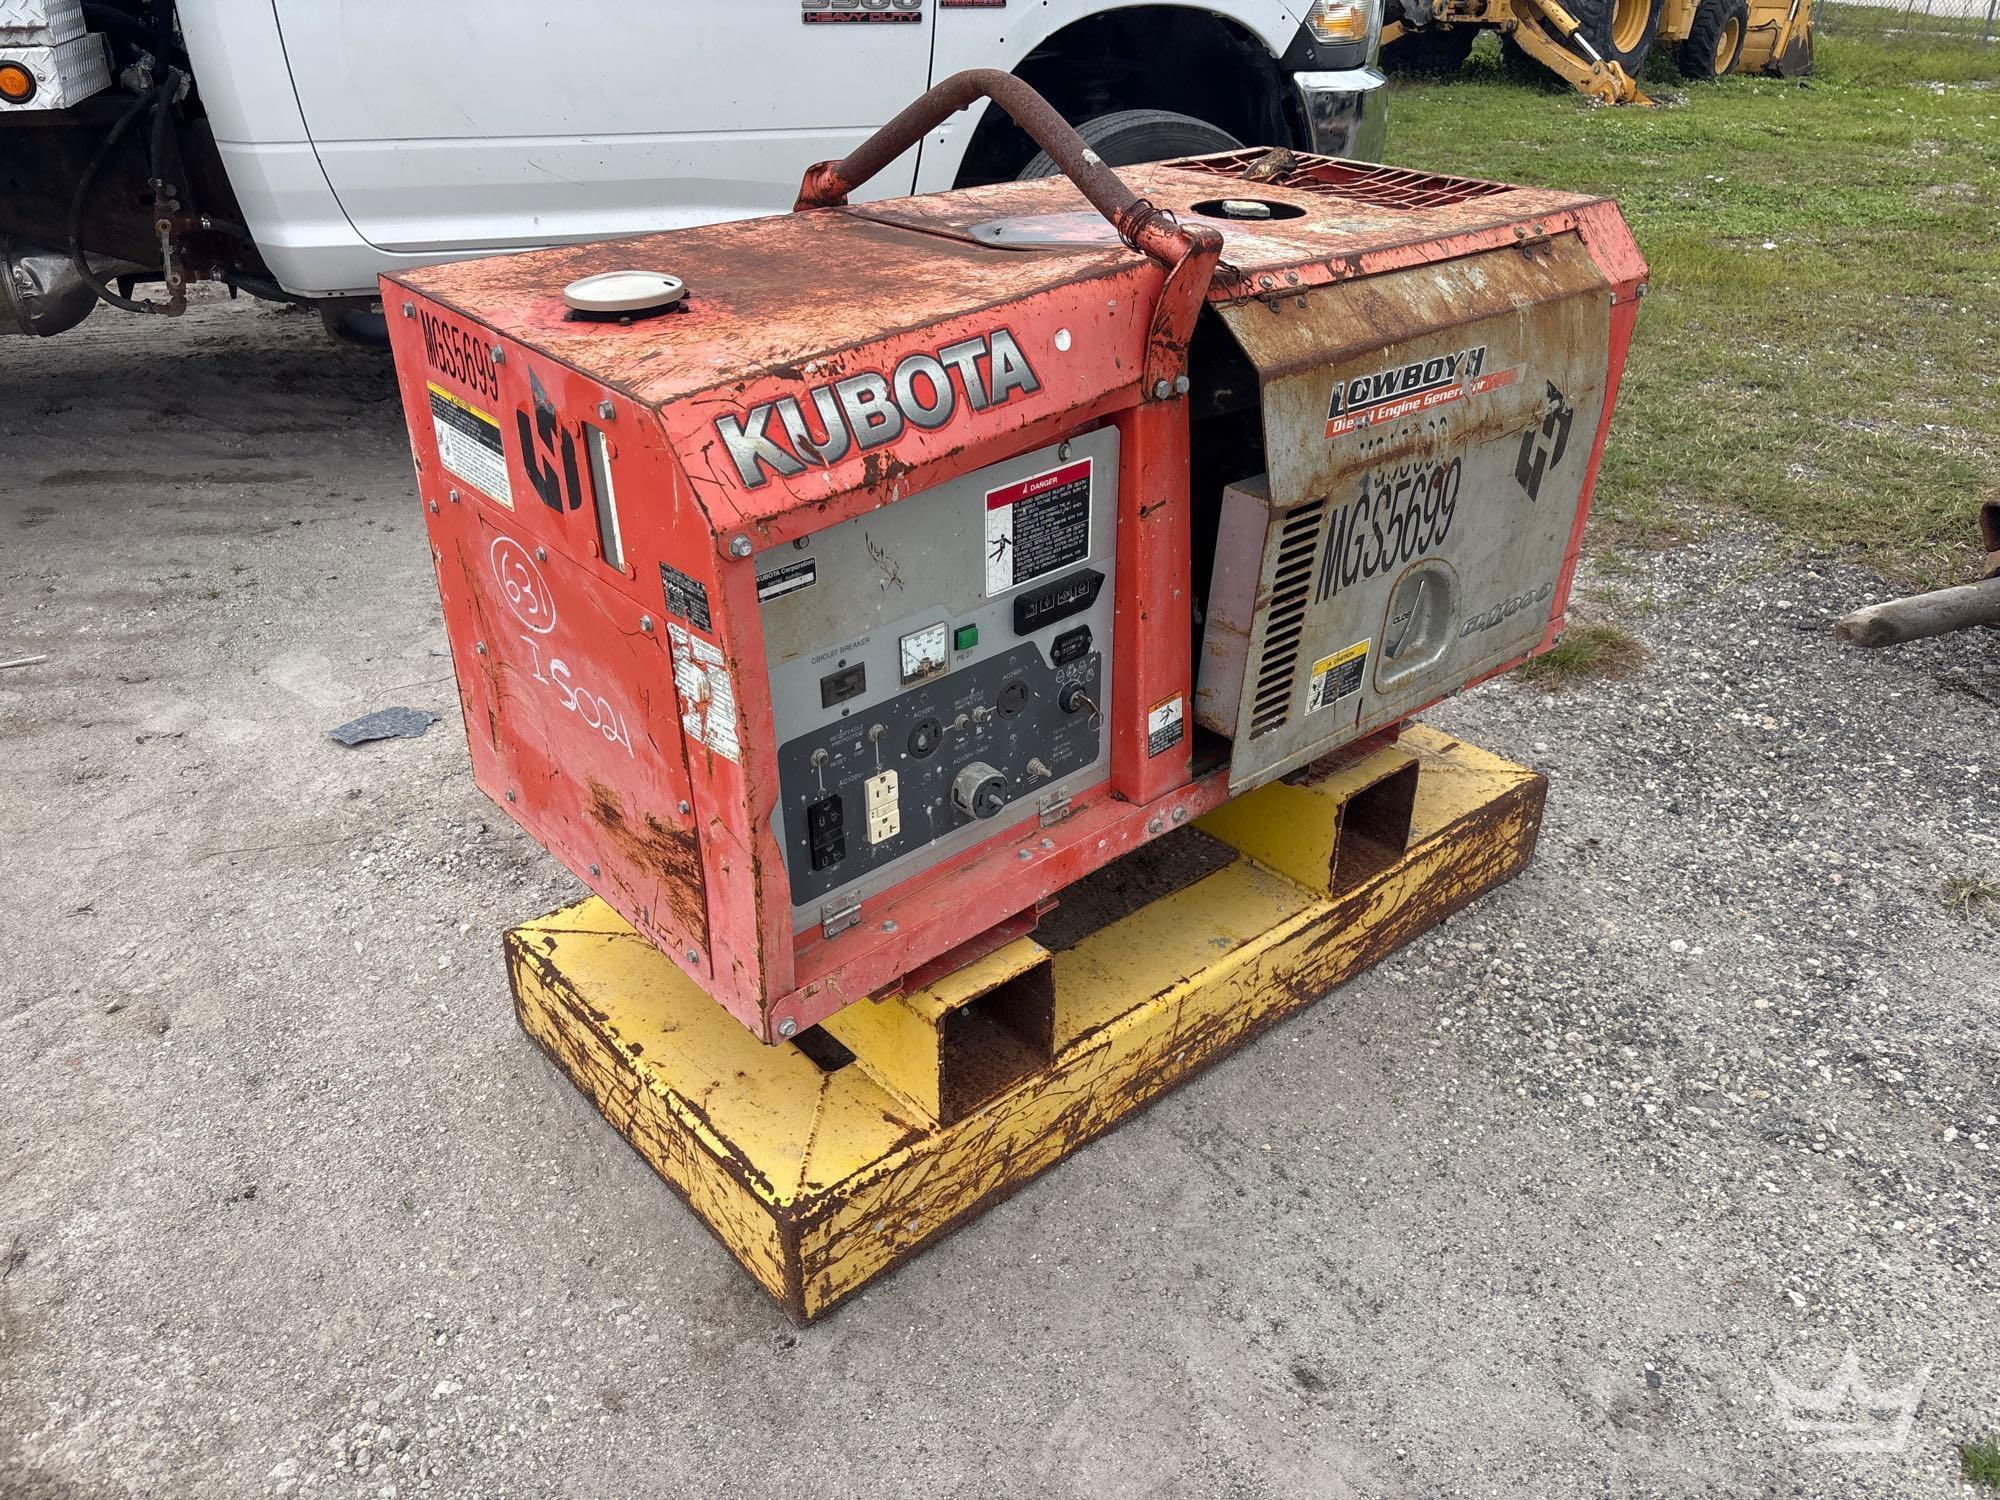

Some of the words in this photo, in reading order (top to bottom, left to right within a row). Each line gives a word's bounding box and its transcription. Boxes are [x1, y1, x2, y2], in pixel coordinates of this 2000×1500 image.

[806, 12, 866, 22] HEAVY
[869, 12, 918, 22] DUTY
[420, 309, 498, 401] MGS5699
[1328, 352, 1464, 419] LOWBOY
[715, 329, 1041, 488] KUBOTA
[1377, 399, 1421, 420] Engine
[1030, 477, 1058, 492] DANGER
[1315, 457, 1462, 605] MGS5699
[756, 570, 780, 582] KUBOTA
[781, 560, 815, 574] Corporation
[811, 649, 839, 665] CIRCUIT
[840, 637, 870, 654] BREAKER
